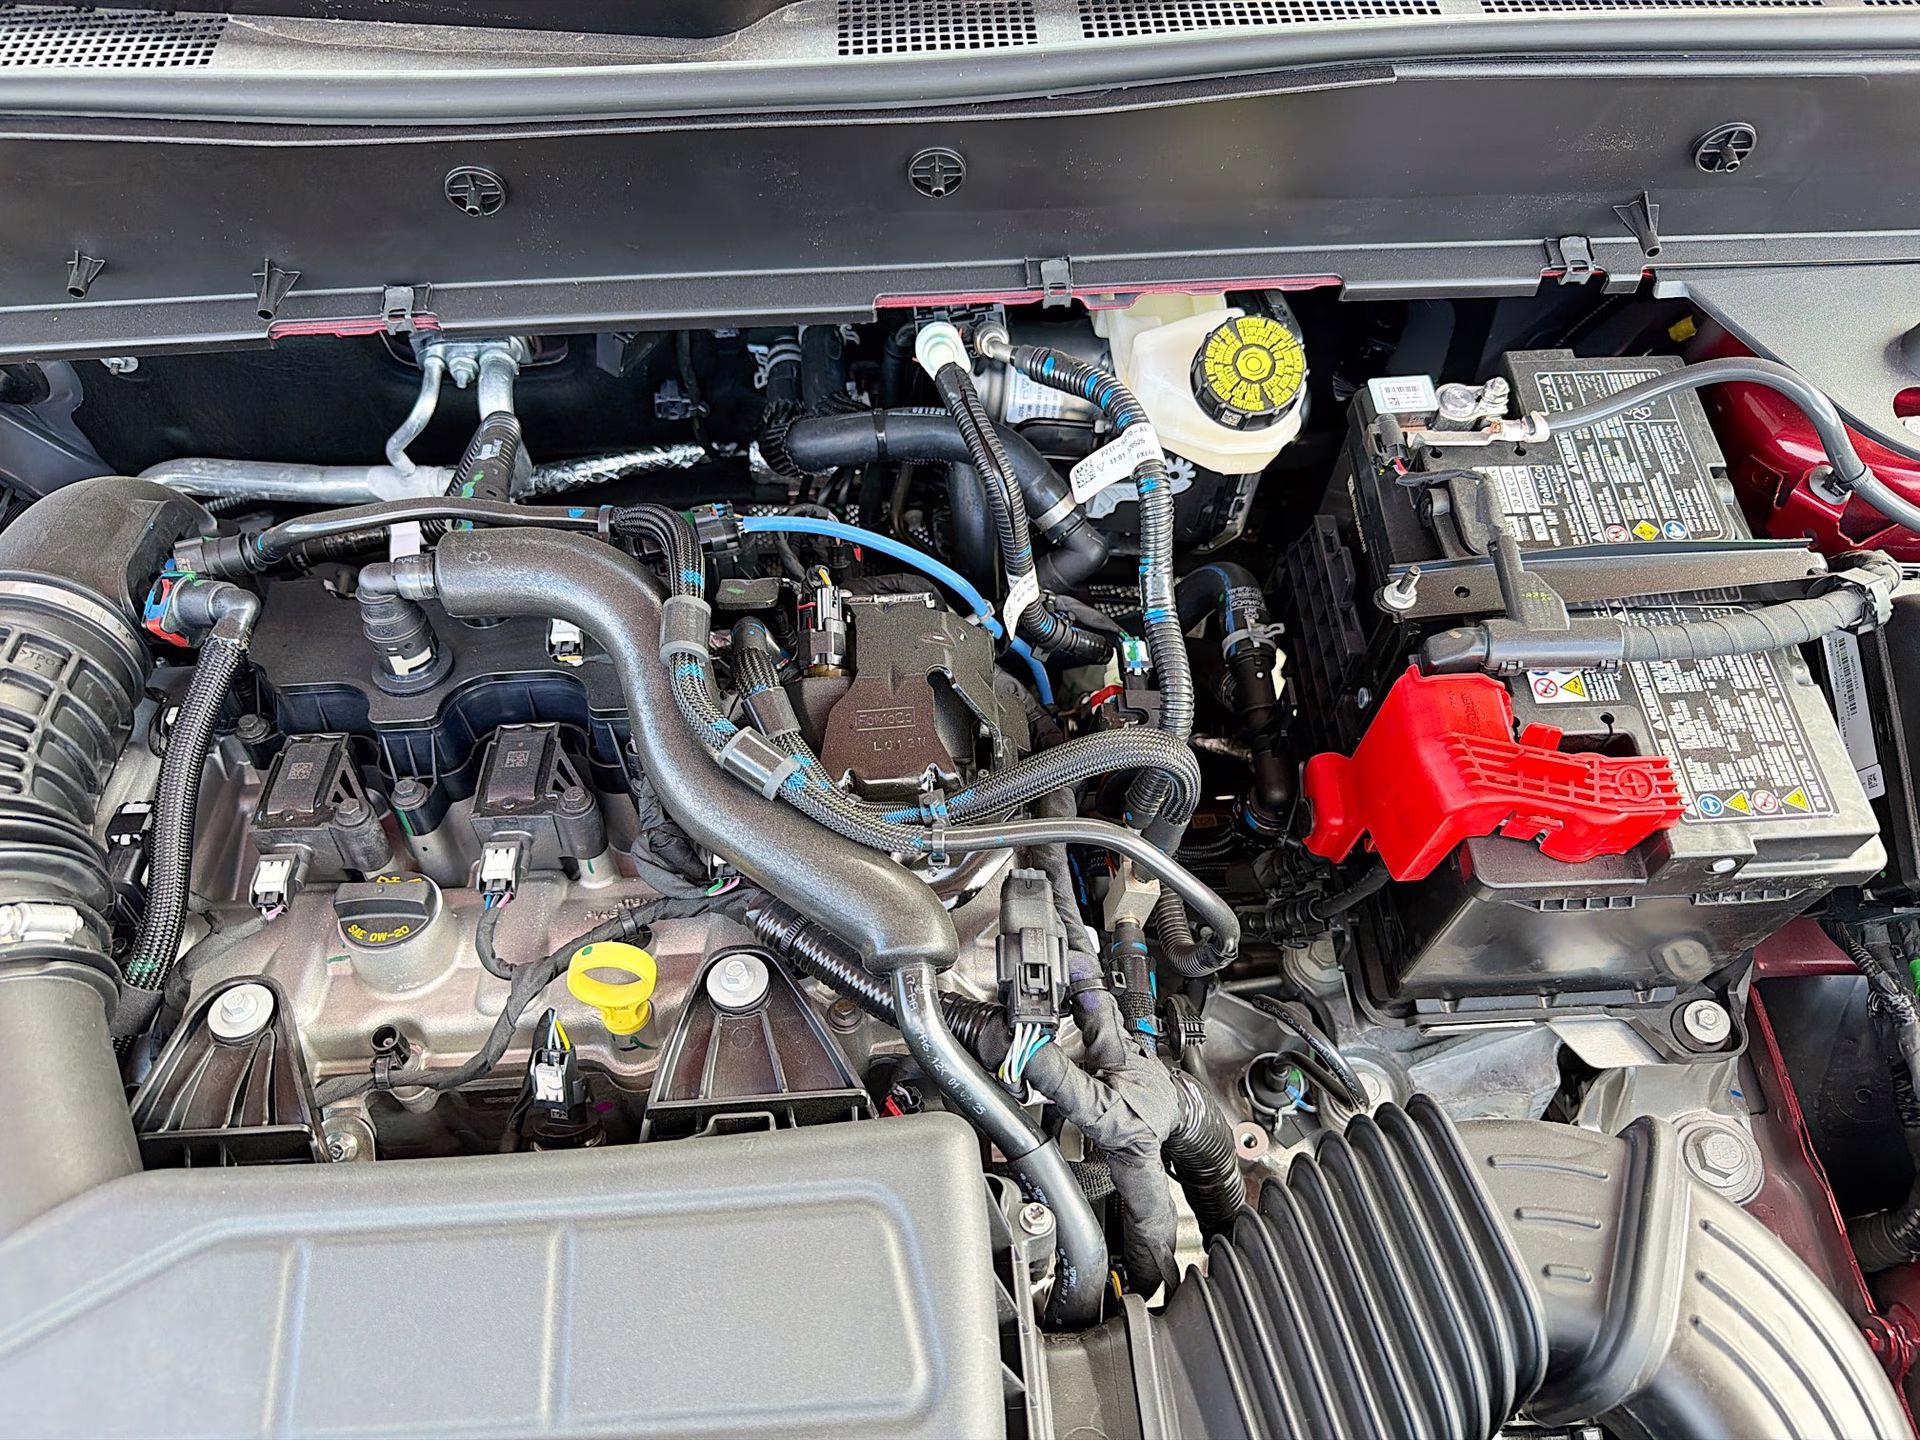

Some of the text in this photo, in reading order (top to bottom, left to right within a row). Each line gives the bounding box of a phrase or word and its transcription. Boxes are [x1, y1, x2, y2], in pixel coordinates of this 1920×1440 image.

[1209, 379, 1232, 403] SEALED
[1556, 431, 1578, 465] PELIGRO/V
[1650, 424, 1675, 475] CONTRA DERRAMES
[1503, 471, 1515, 486] C20
[1531, 466, 1554, 504] FoMoCo
[1572, 478, 1601, 533] DANGER/POISON
[1674, 489, 1696, 532] NON-SPILLABLE
[1681, 487, 1694, 506] Battery
[1532, 520, 1544, 534] 12V
[1541, 507, 1560, 525] MF
[1629, 660, 1662, 721] PELIGRO/VENEN
[858, 711, 912, 726] FoMoCo
[1753, 655, 1826, 808] DO NOT OPEN. NE PAS OUVRIR. NO LA ABRA.
[347, 924, 410, 942] SAE 0W-20
